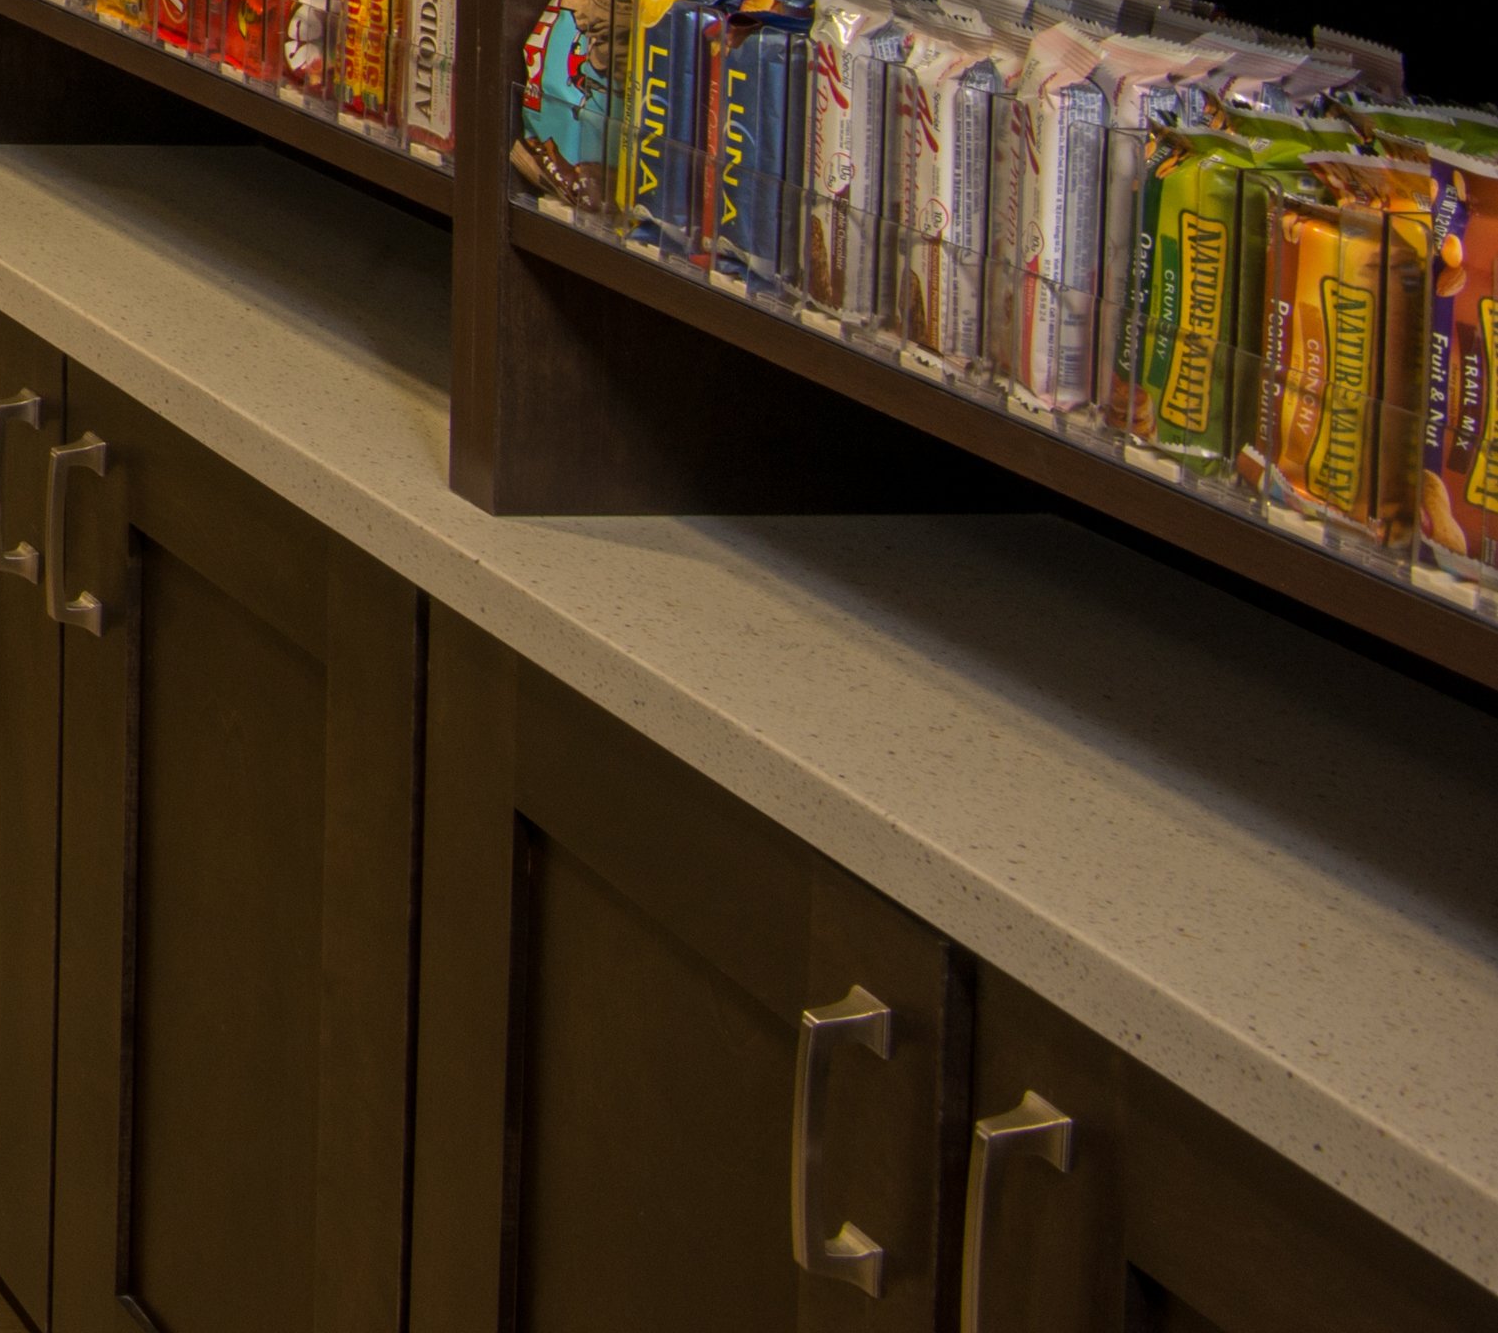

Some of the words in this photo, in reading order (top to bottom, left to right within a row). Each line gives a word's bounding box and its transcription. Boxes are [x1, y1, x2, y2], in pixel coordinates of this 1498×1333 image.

[638, 43, 669, 195] LUNA
[720, 67, 749, 226] LUNA
[1155, 268, 1176, 361] CRUNCHY
[1192, 215, 1227, 333] NATURE
[1162, 329, 1213, 433] VALLEY
[1300, 336, 1322, 437] CRUNCHY
[1331, 281, 1373, 391] NATURE
[1429, 332, 1450, 379] Fruit
[1429, 385, 1446, 403] &
[1313, 393, 1362, 513] VALLEY
